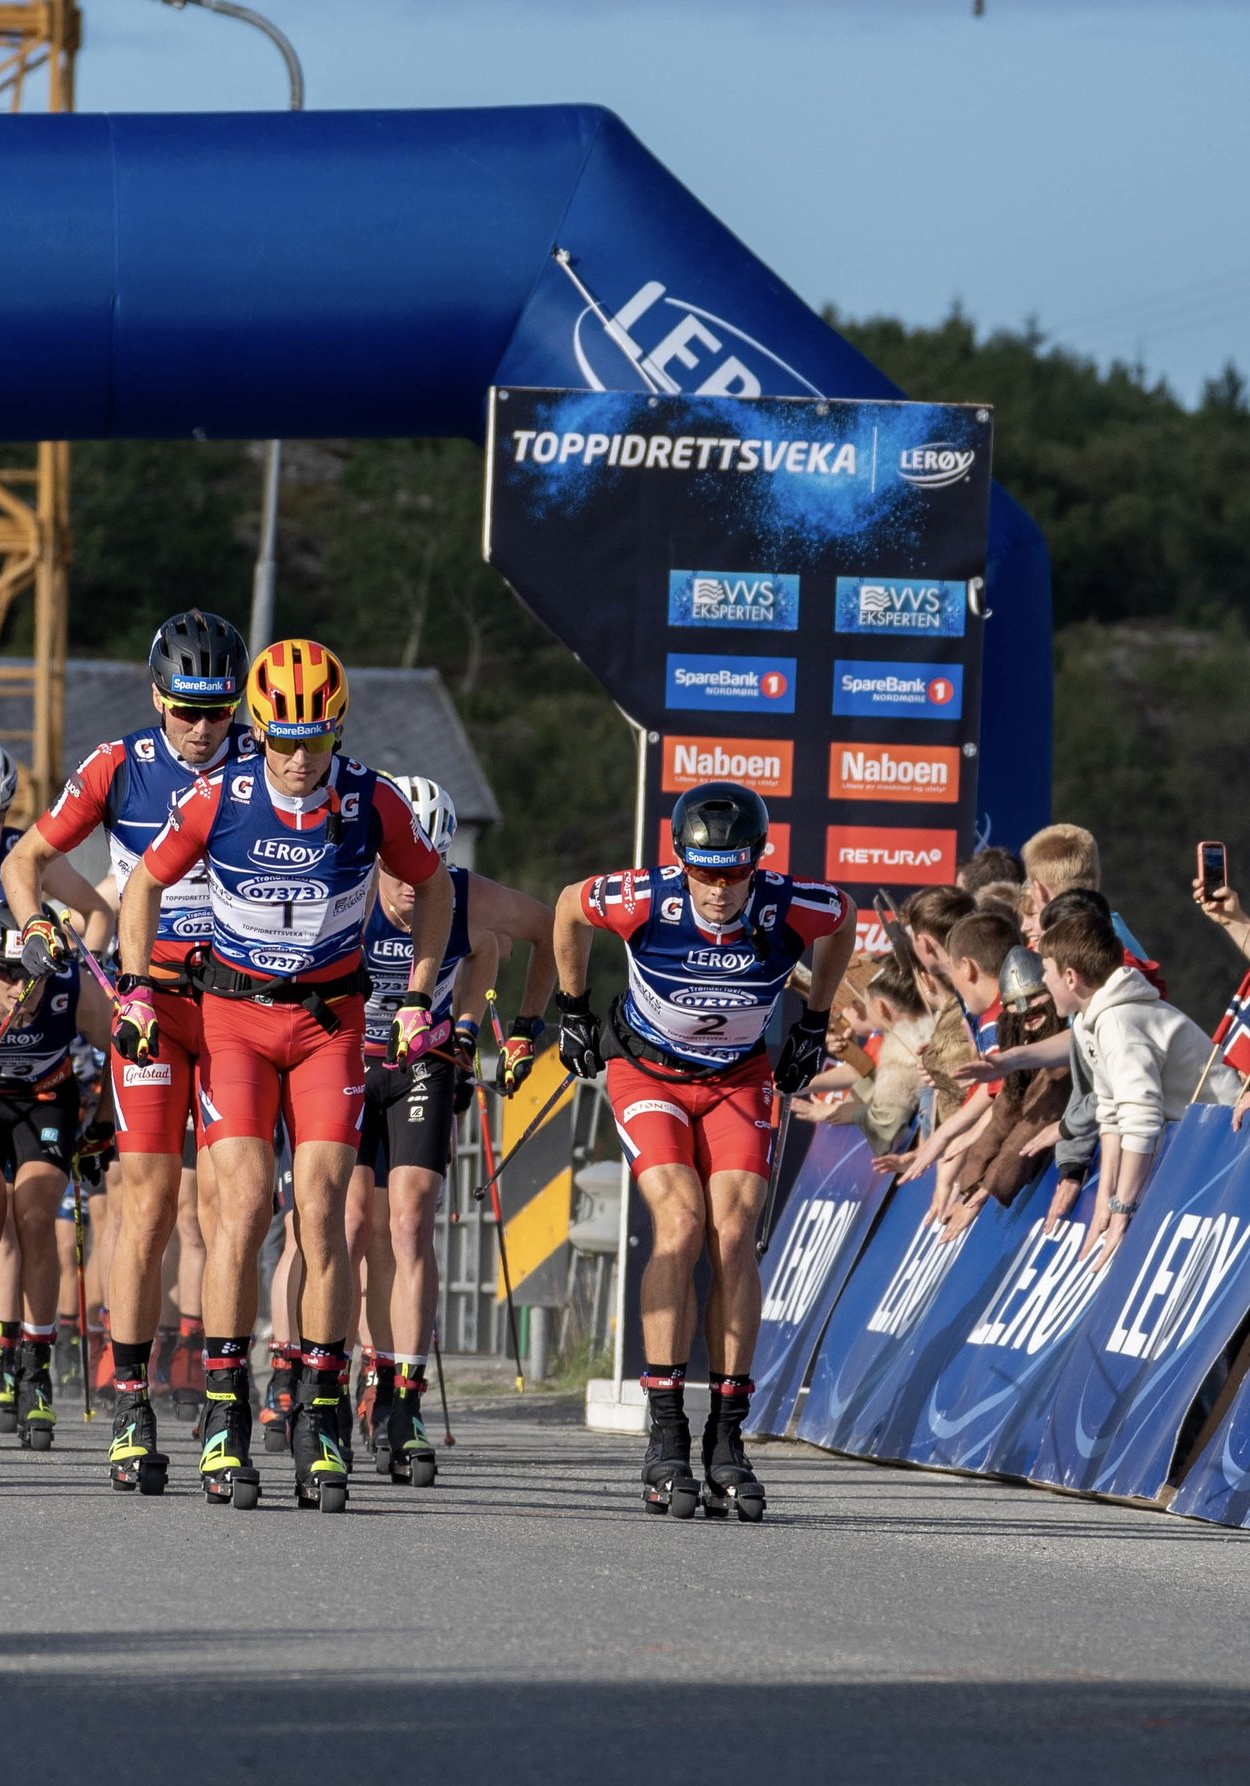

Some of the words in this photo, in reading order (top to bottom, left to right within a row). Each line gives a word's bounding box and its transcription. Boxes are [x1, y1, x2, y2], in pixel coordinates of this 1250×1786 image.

[603, 280, 762, 399] LER
[513, 430, 857, 474] TOPPIDRETTSVEKA
[900, 450, 971, 472] LERØY
[724, 580, 774, 605] VVS
[890, 587, 940, 612] VVS
[692, 604, 774, 621] EKSPERTEN
[858, 611, 940, 628] EKSPERTEN
[173, 678, 223, 691] SpareBank
[675, 668, 759, 687] SpareBank
[767, 675, 779, 694] 1
[842, 674, 926, 693] SpareBank
[934, 682, 946, 700] 1
[705, 686, 759, 697] NORDMØRE
[873, 693, 926, 703] NORDMØRE
[270, 723, 322, 736] SpareBank
[674, 744, 781, 778] Naboen
[842, 751, 948, 784] Naboen
[253, 839, 321, 863] LERØY
[688, 850, 738, 864] SpareBank
[839, 847, 932, 866] RETURA
[250, 887, 316, 900] 07373
[623, 871, 633, 902] CRAFT
[186, 911, 214, 919] Trønder
[272, 900, 293, 929] 1
[183, 923, 213, 934] 073
[242, 923, 303, 937] TOPPIDRETTSVEKA
[373, 940, 414, 958] LERØ
[687, 950, 751, 969] LERØY
[365, 1029, 390, 1037] 073
[693, 1014, 728, 1036] 2
[430, 1028, 446, 1045] XA
[125, 1065, 170, 1083] Grilstad
[343, 1085, 366, 1095] CRAF
